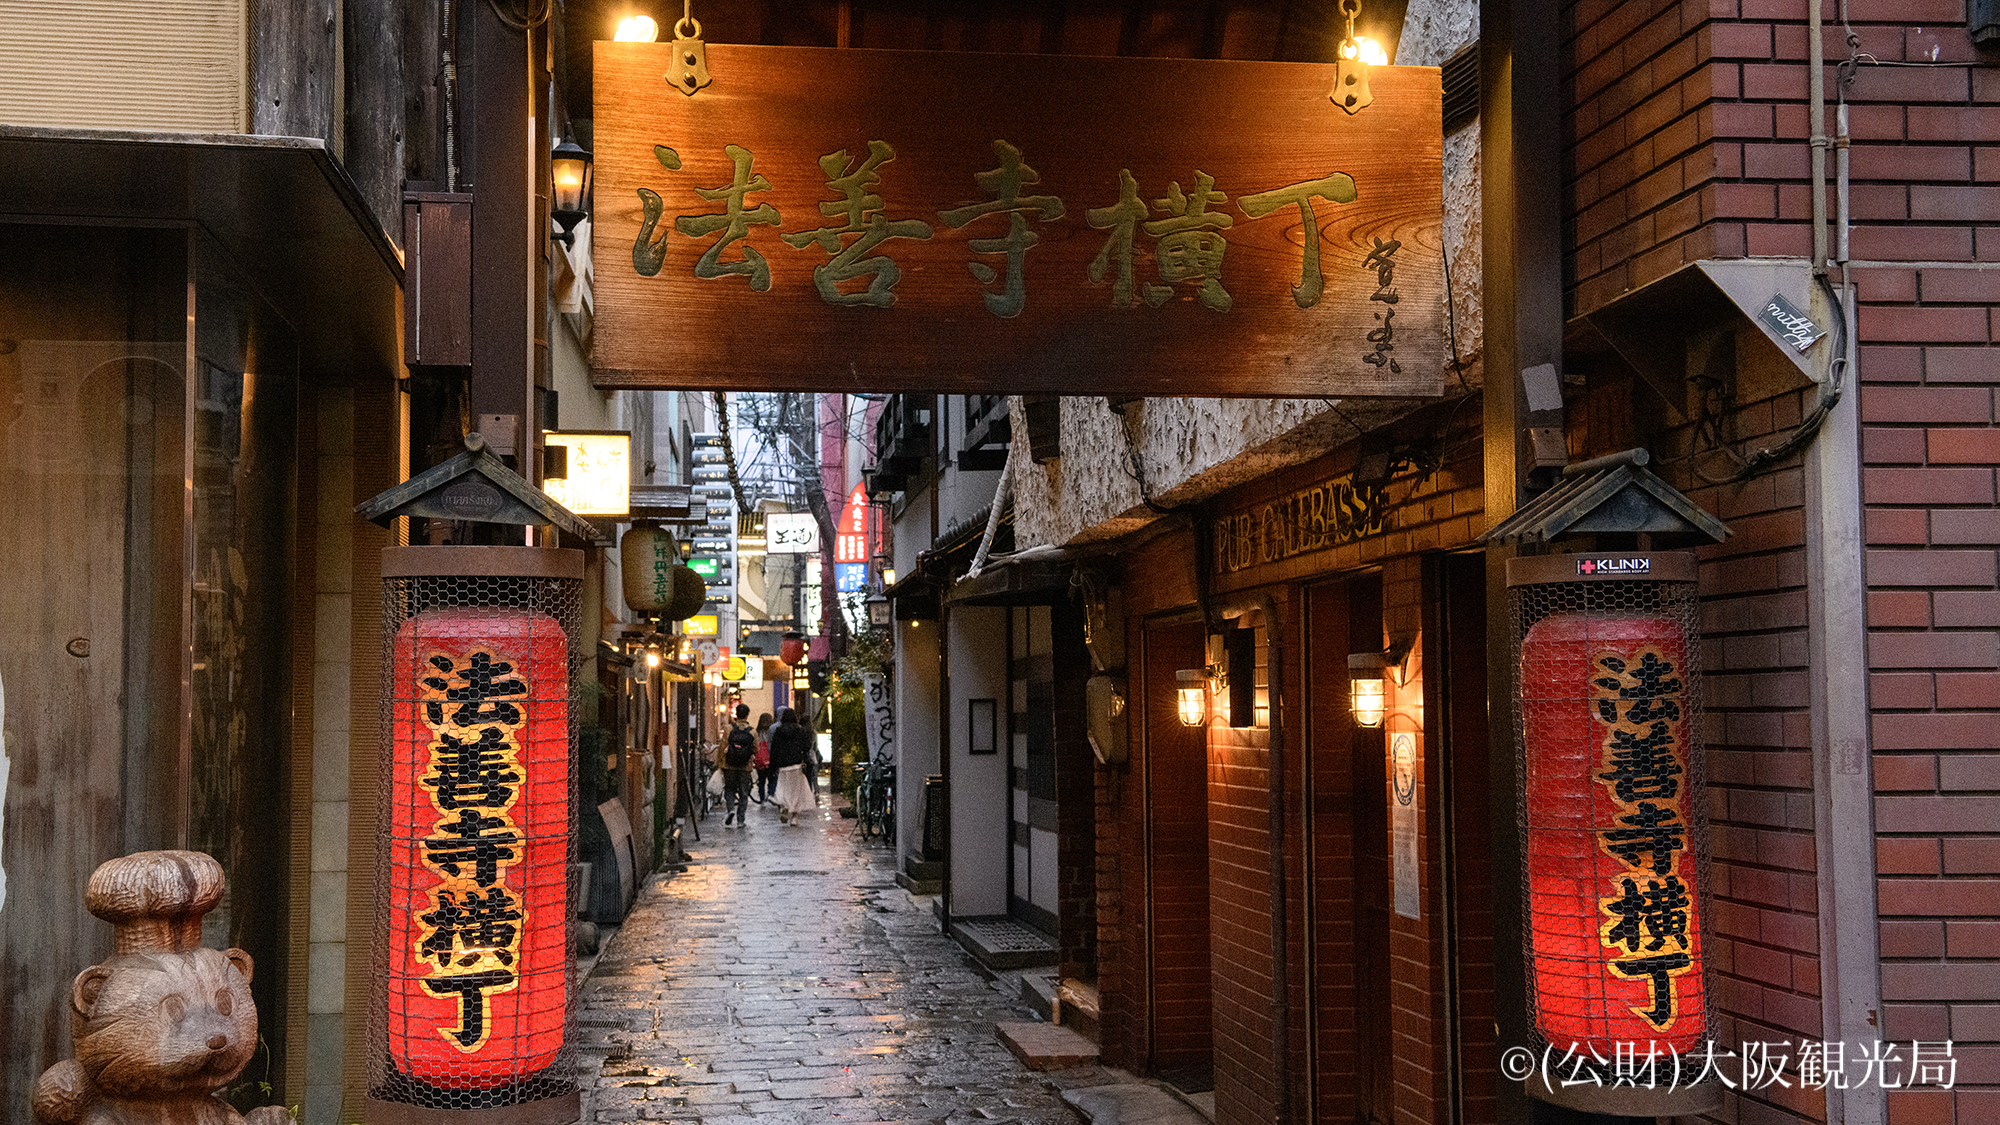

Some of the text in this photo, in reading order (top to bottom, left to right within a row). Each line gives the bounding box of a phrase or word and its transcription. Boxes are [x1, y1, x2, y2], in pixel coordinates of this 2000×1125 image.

[632, 139, 1358, 318] 法善寺横丁
[774, 527, 813, 545] 王道
[1218, 513, 1253, 574] PUB
[1597, 559, 1650, 570] KLINIK
[420, 650, 527, 1048] 法善寺横丁
[1596, 651, 1694, 1030] 法善寺横丁
